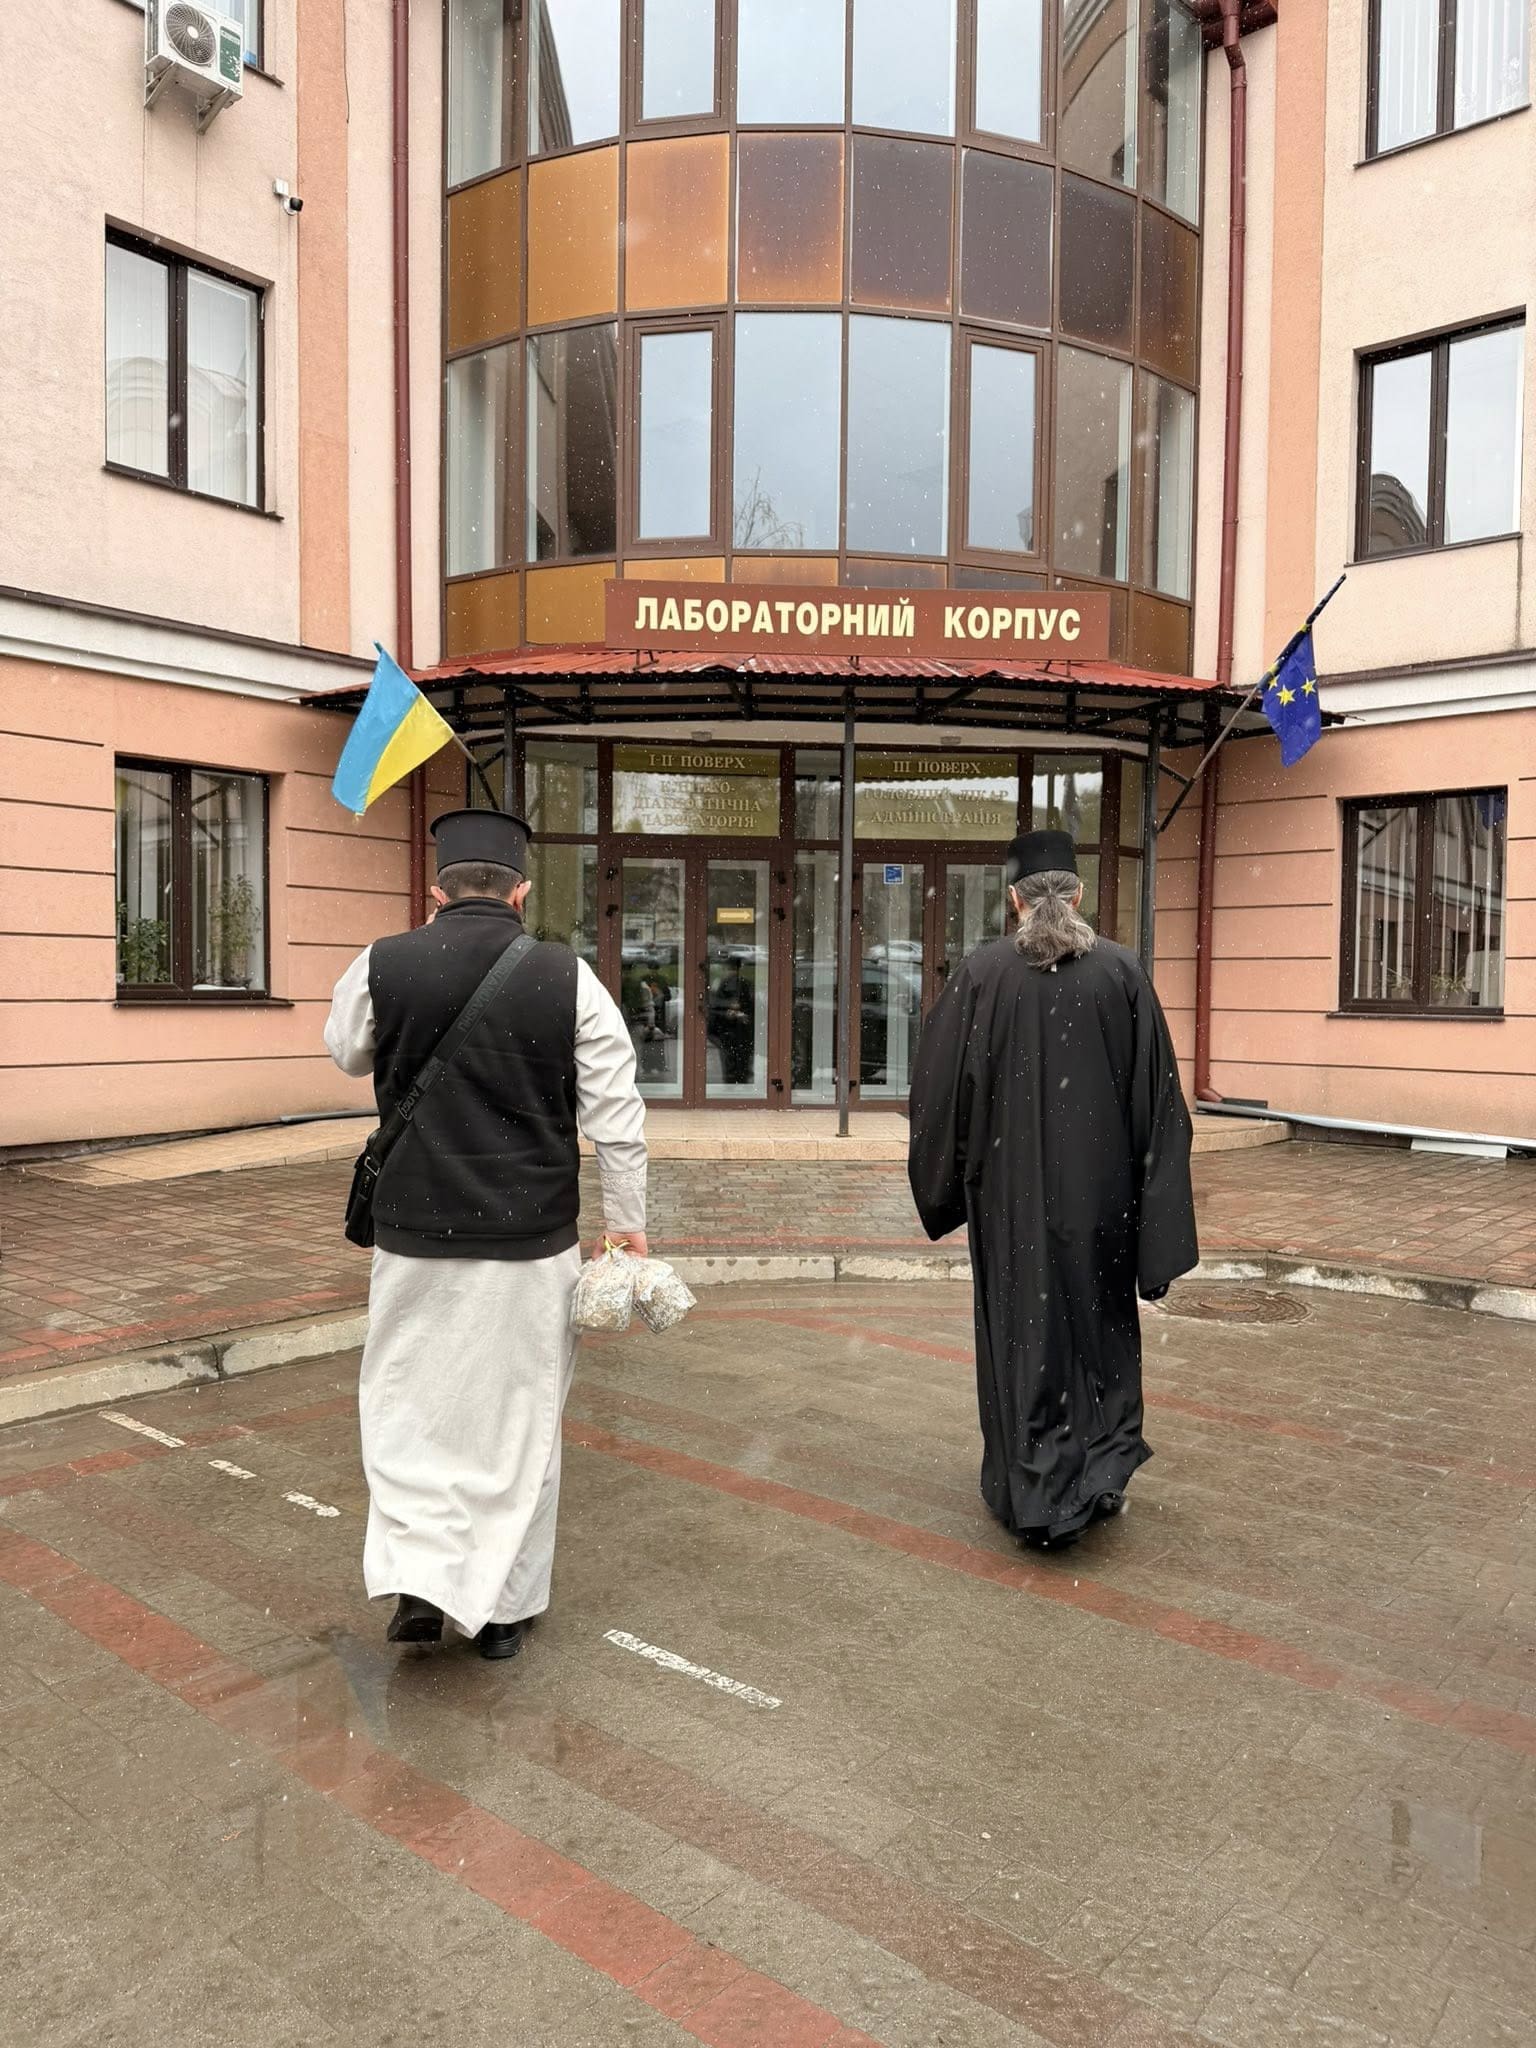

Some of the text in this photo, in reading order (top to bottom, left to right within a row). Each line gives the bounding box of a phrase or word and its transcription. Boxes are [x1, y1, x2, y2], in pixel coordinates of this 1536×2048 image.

[635, 597, 1081, 641] ЛАБОРАТОРНИЙ КОРПУС
[681, 755, 746, 769] ПОВЕРХ
[918, 761, 982, 774] ПОВЕРХ
